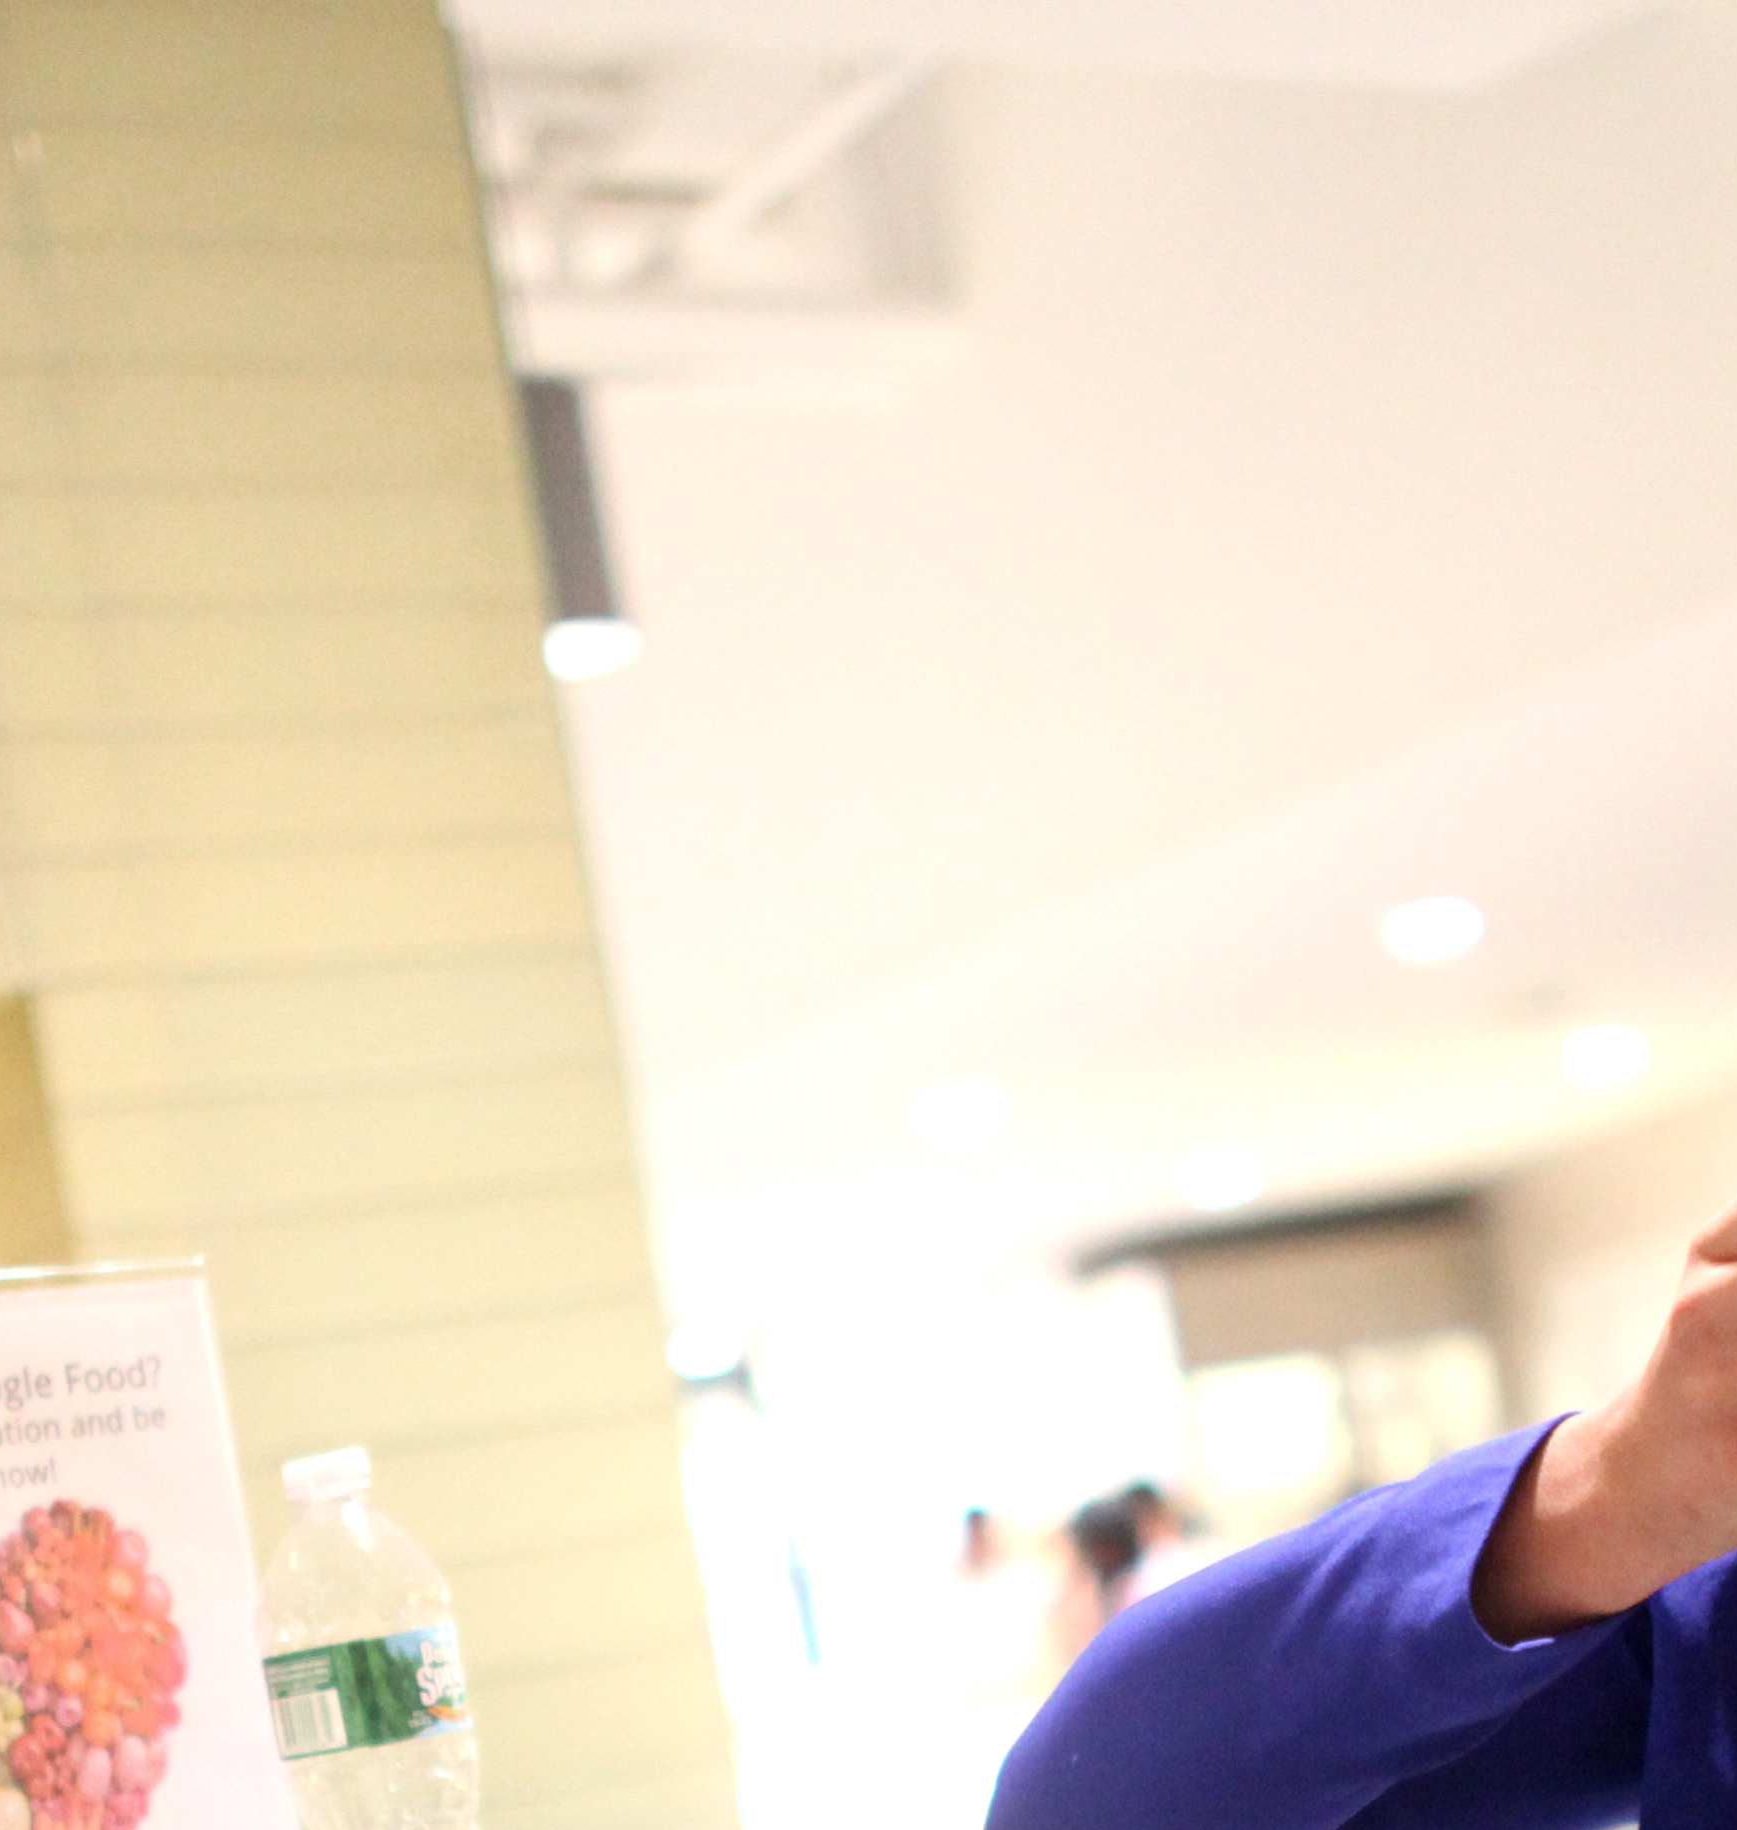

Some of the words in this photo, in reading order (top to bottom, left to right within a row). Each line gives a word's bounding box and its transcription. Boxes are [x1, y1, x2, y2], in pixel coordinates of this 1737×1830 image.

[64, 1355, 162, 1395] Food?
[70, 1406, 123, 1439] and
[133, 1403, 166, 1430] be
